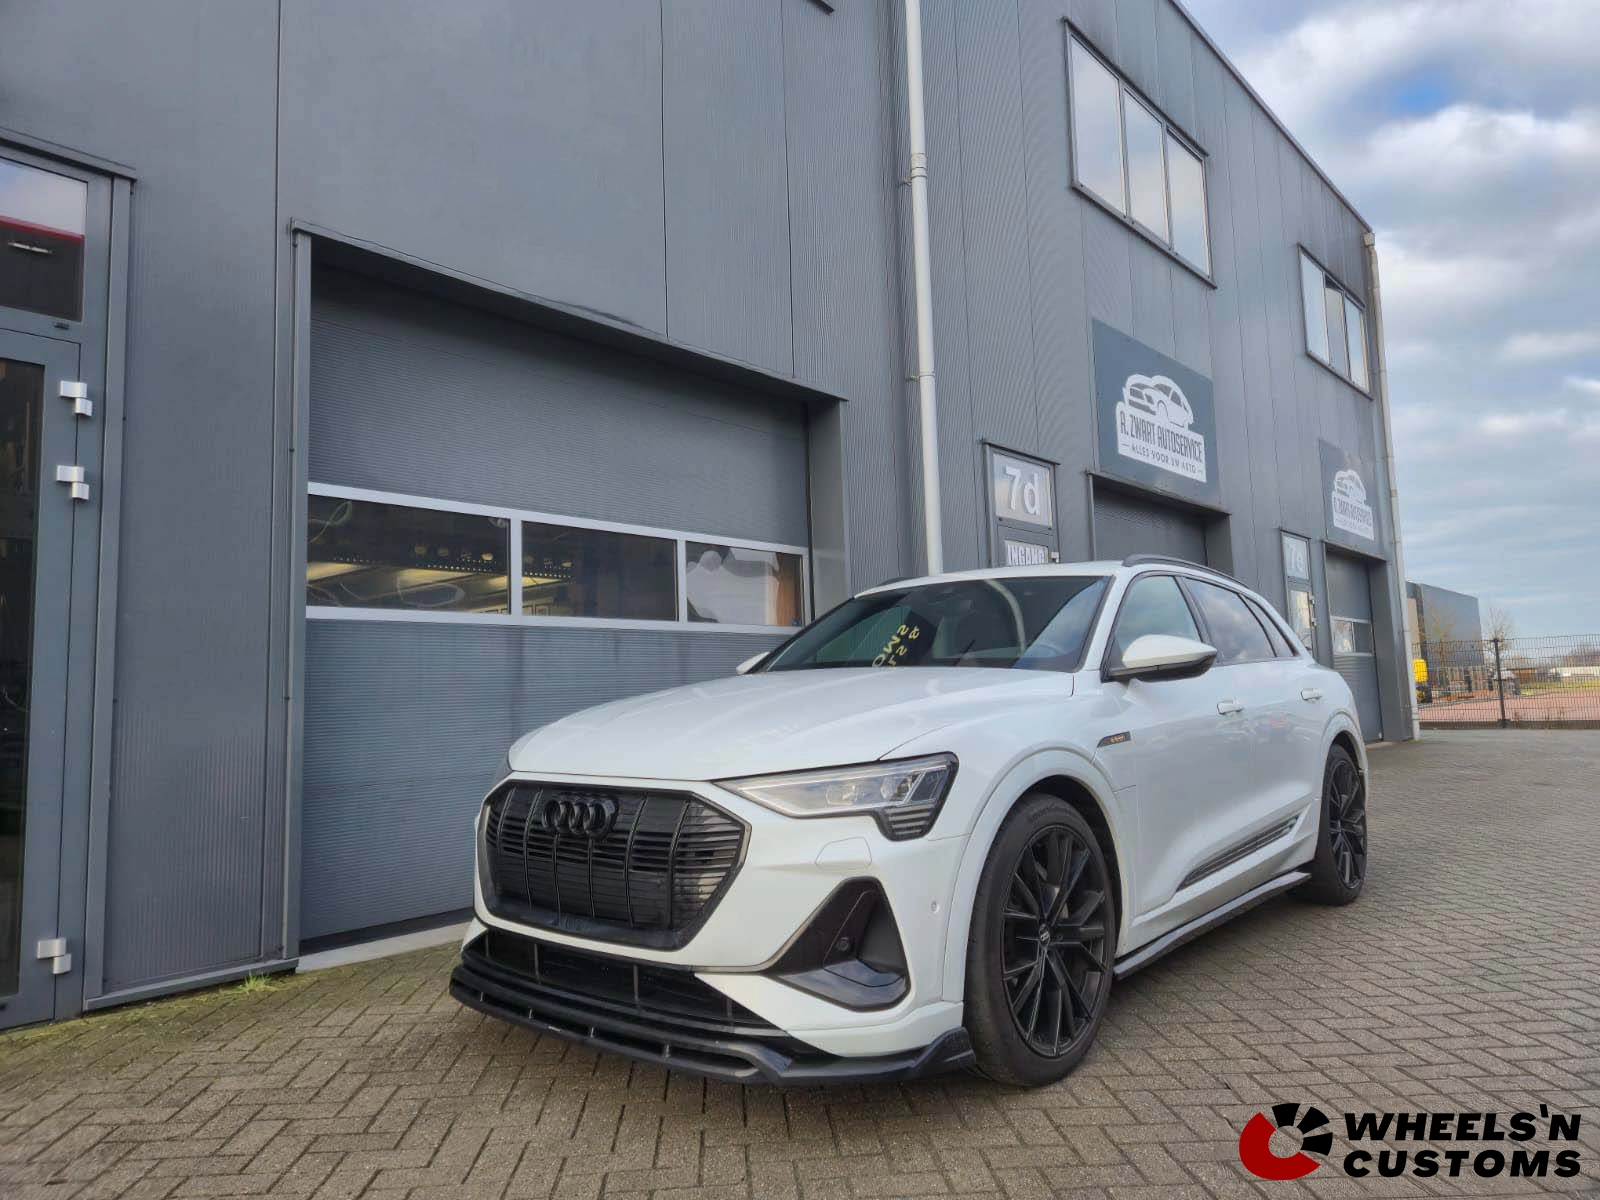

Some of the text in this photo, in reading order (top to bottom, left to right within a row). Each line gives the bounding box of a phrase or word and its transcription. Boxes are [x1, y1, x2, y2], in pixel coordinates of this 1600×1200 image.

[1120, 411, 1203, 463] A. ZWART AUTOSERVICE
[1131, 443, 1149, 457] ALLES
[1152, 450, 1168, 463] VOOR
[1005, 465, 1041, 516] 7d
